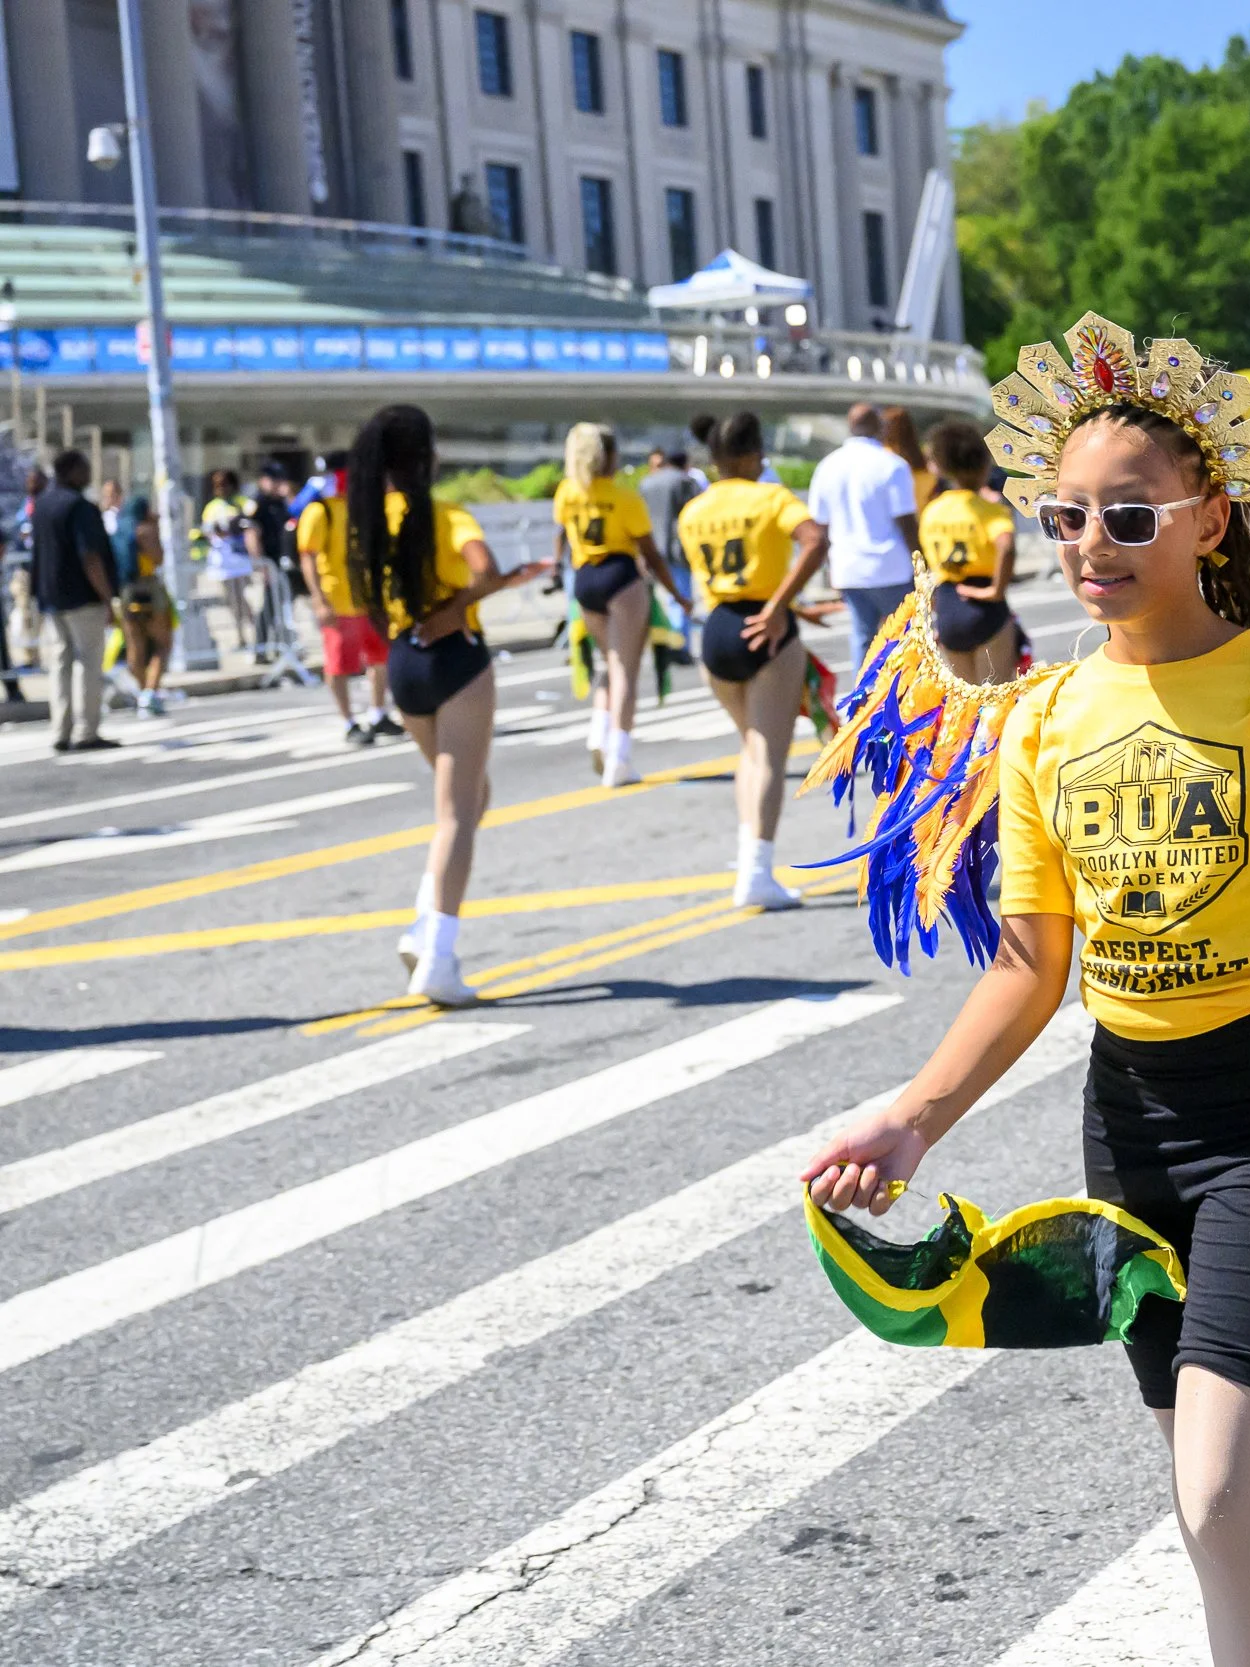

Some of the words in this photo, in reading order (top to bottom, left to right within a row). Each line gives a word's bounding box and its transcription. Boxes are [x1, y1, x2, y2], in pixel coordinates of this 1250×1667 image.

[700, 538, 746, 586] 14
[1065, 774, 1240, 852] BUA
[1166, 844, 1240, 867] UNITED
[1089, 937, 1219, 962] RESPECT.
